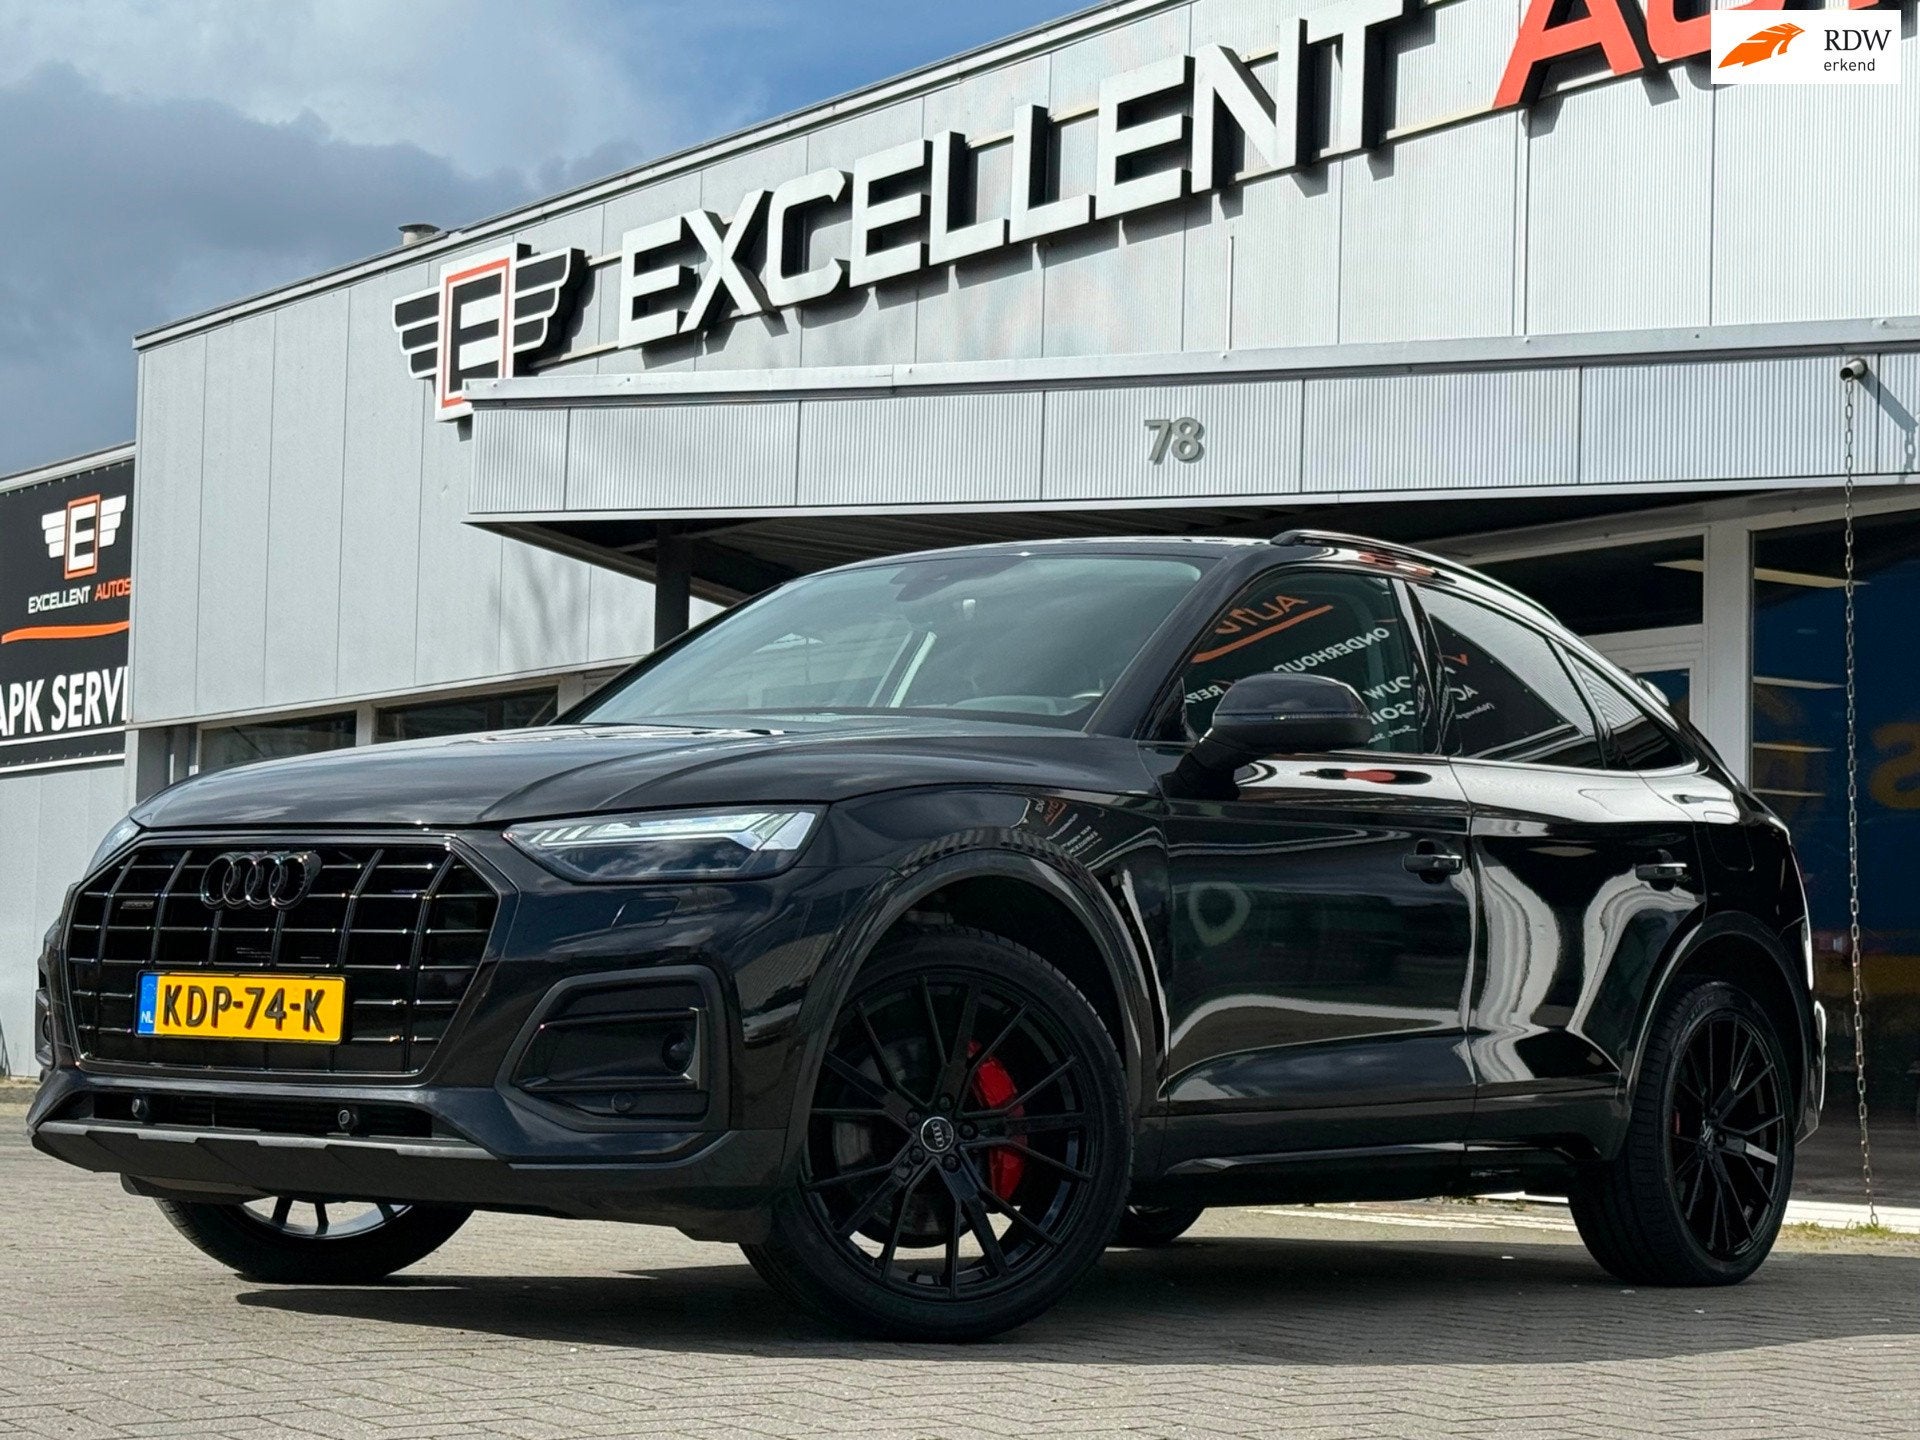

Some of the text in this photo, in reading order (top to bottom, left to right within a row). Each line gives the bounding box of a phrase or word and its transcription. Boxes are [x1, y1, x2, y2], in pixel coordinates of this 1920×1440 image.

[617, 0, 1404, 350] EXCELLENT
[1143, 416, 1204, 465] 78
[28, 578, 131, 614] EXCELLENT AUTOS
[141, 984, 326, 1033] NL KDP-74-K
